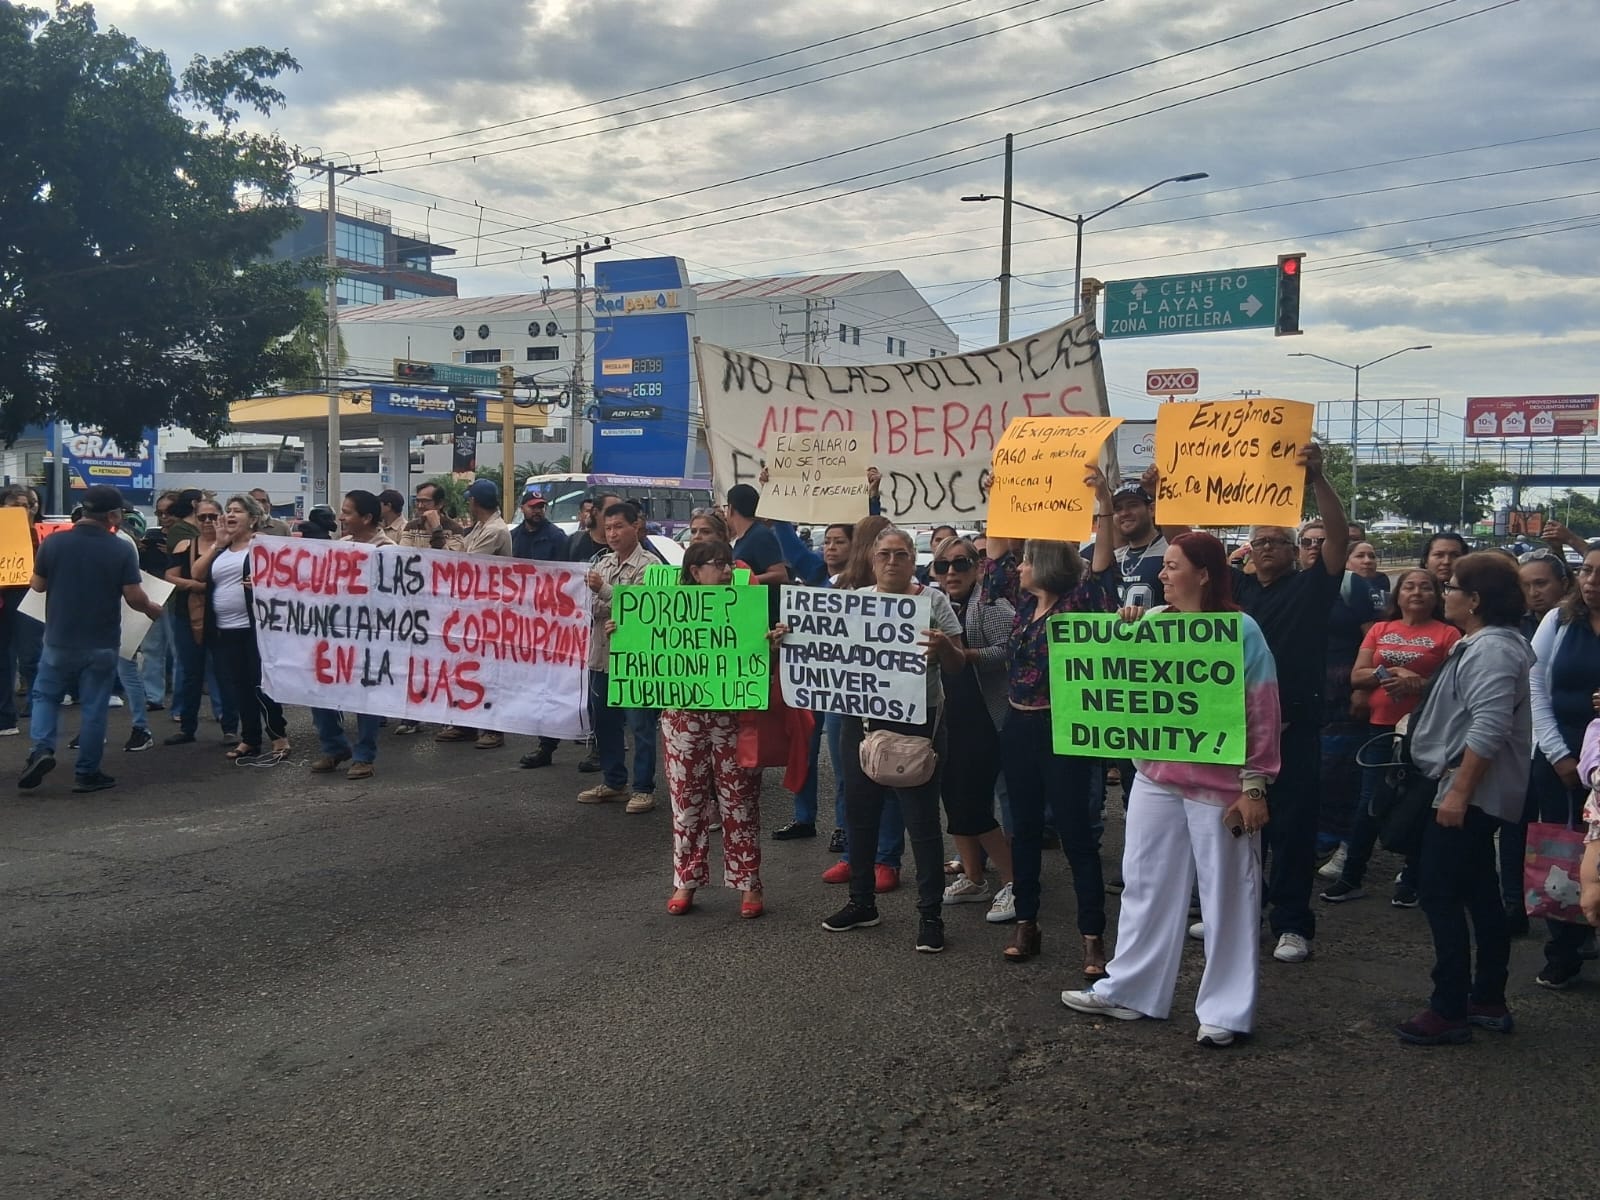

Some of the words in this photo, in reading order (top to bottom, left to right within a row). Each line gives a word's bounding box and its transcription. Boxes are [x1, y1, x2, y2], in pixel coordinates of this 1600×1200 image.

[1160, 275, 1248, 296] CENTRO
[1128, 296, 1215, 316] PLAYAS
[1111, 318, 1148, 335] ZONA
[1159, 310, 1232, 330] HOTELERA
[722, 350, 773, 394] NO
[786, 359, 815, 399] A
[817, 363, 891, 394] LAS
[894, 318, 1100, 393] POLITICAS
[633, 383, 662, 397] 26.89
[1148, 374, 1196, 390] OXXO
[1189, 401, 1285, 437] Exigimos
[777, 436, 796, 453] EL
[800, 437, 857, 453] SALARIO
[995, 449, 1025, 466] PAGO
[1031, 447, 1044, 462] de
[1271, 440, 1297, 459] en
[774, 457, 792, 470] NO
[796, 456, 814, 467] SE
[817, 456, 846, 467] TOCA
[801, 470, 822, 483] NO
[994, 474, 1039, 494] quincena
[1044, 474, 1053, 492] y
[772, 484, 781, 498] A
[784, 484, 797, 497] LA
[377, 552, 425, 597] LAS
[786, 590, 917, 620] ¡RESPETO
[256, 598, 430, 646] DENUNCIAMOS
[787, 614, 849, 638] PARA
[864, 622, 915, 644] LOS
[1051, 618, 1238, 645] EDUCATION
[651, 626, 737, 650] MORENA
[314, 640, 355, 686] EN
[360, 649, 394, 688] LA
[610, 652, 709, 678] TRAICIONA
[716, 655, 727, 676] A
[738, 653, 767, 677] LOS
[781, 642, 926, 675] TRABAJADORES
[1065, 657, 1094, 682] IN
[1102, 657, 1235, 685] MEXICO
[789, 666, 891, 693] UNIVER-
[611, 679, 714, 708] JUBILADOS
[795, 688, 916, 723] SITARIOS!
[1081, 688, 1199, 716] NEEDS
